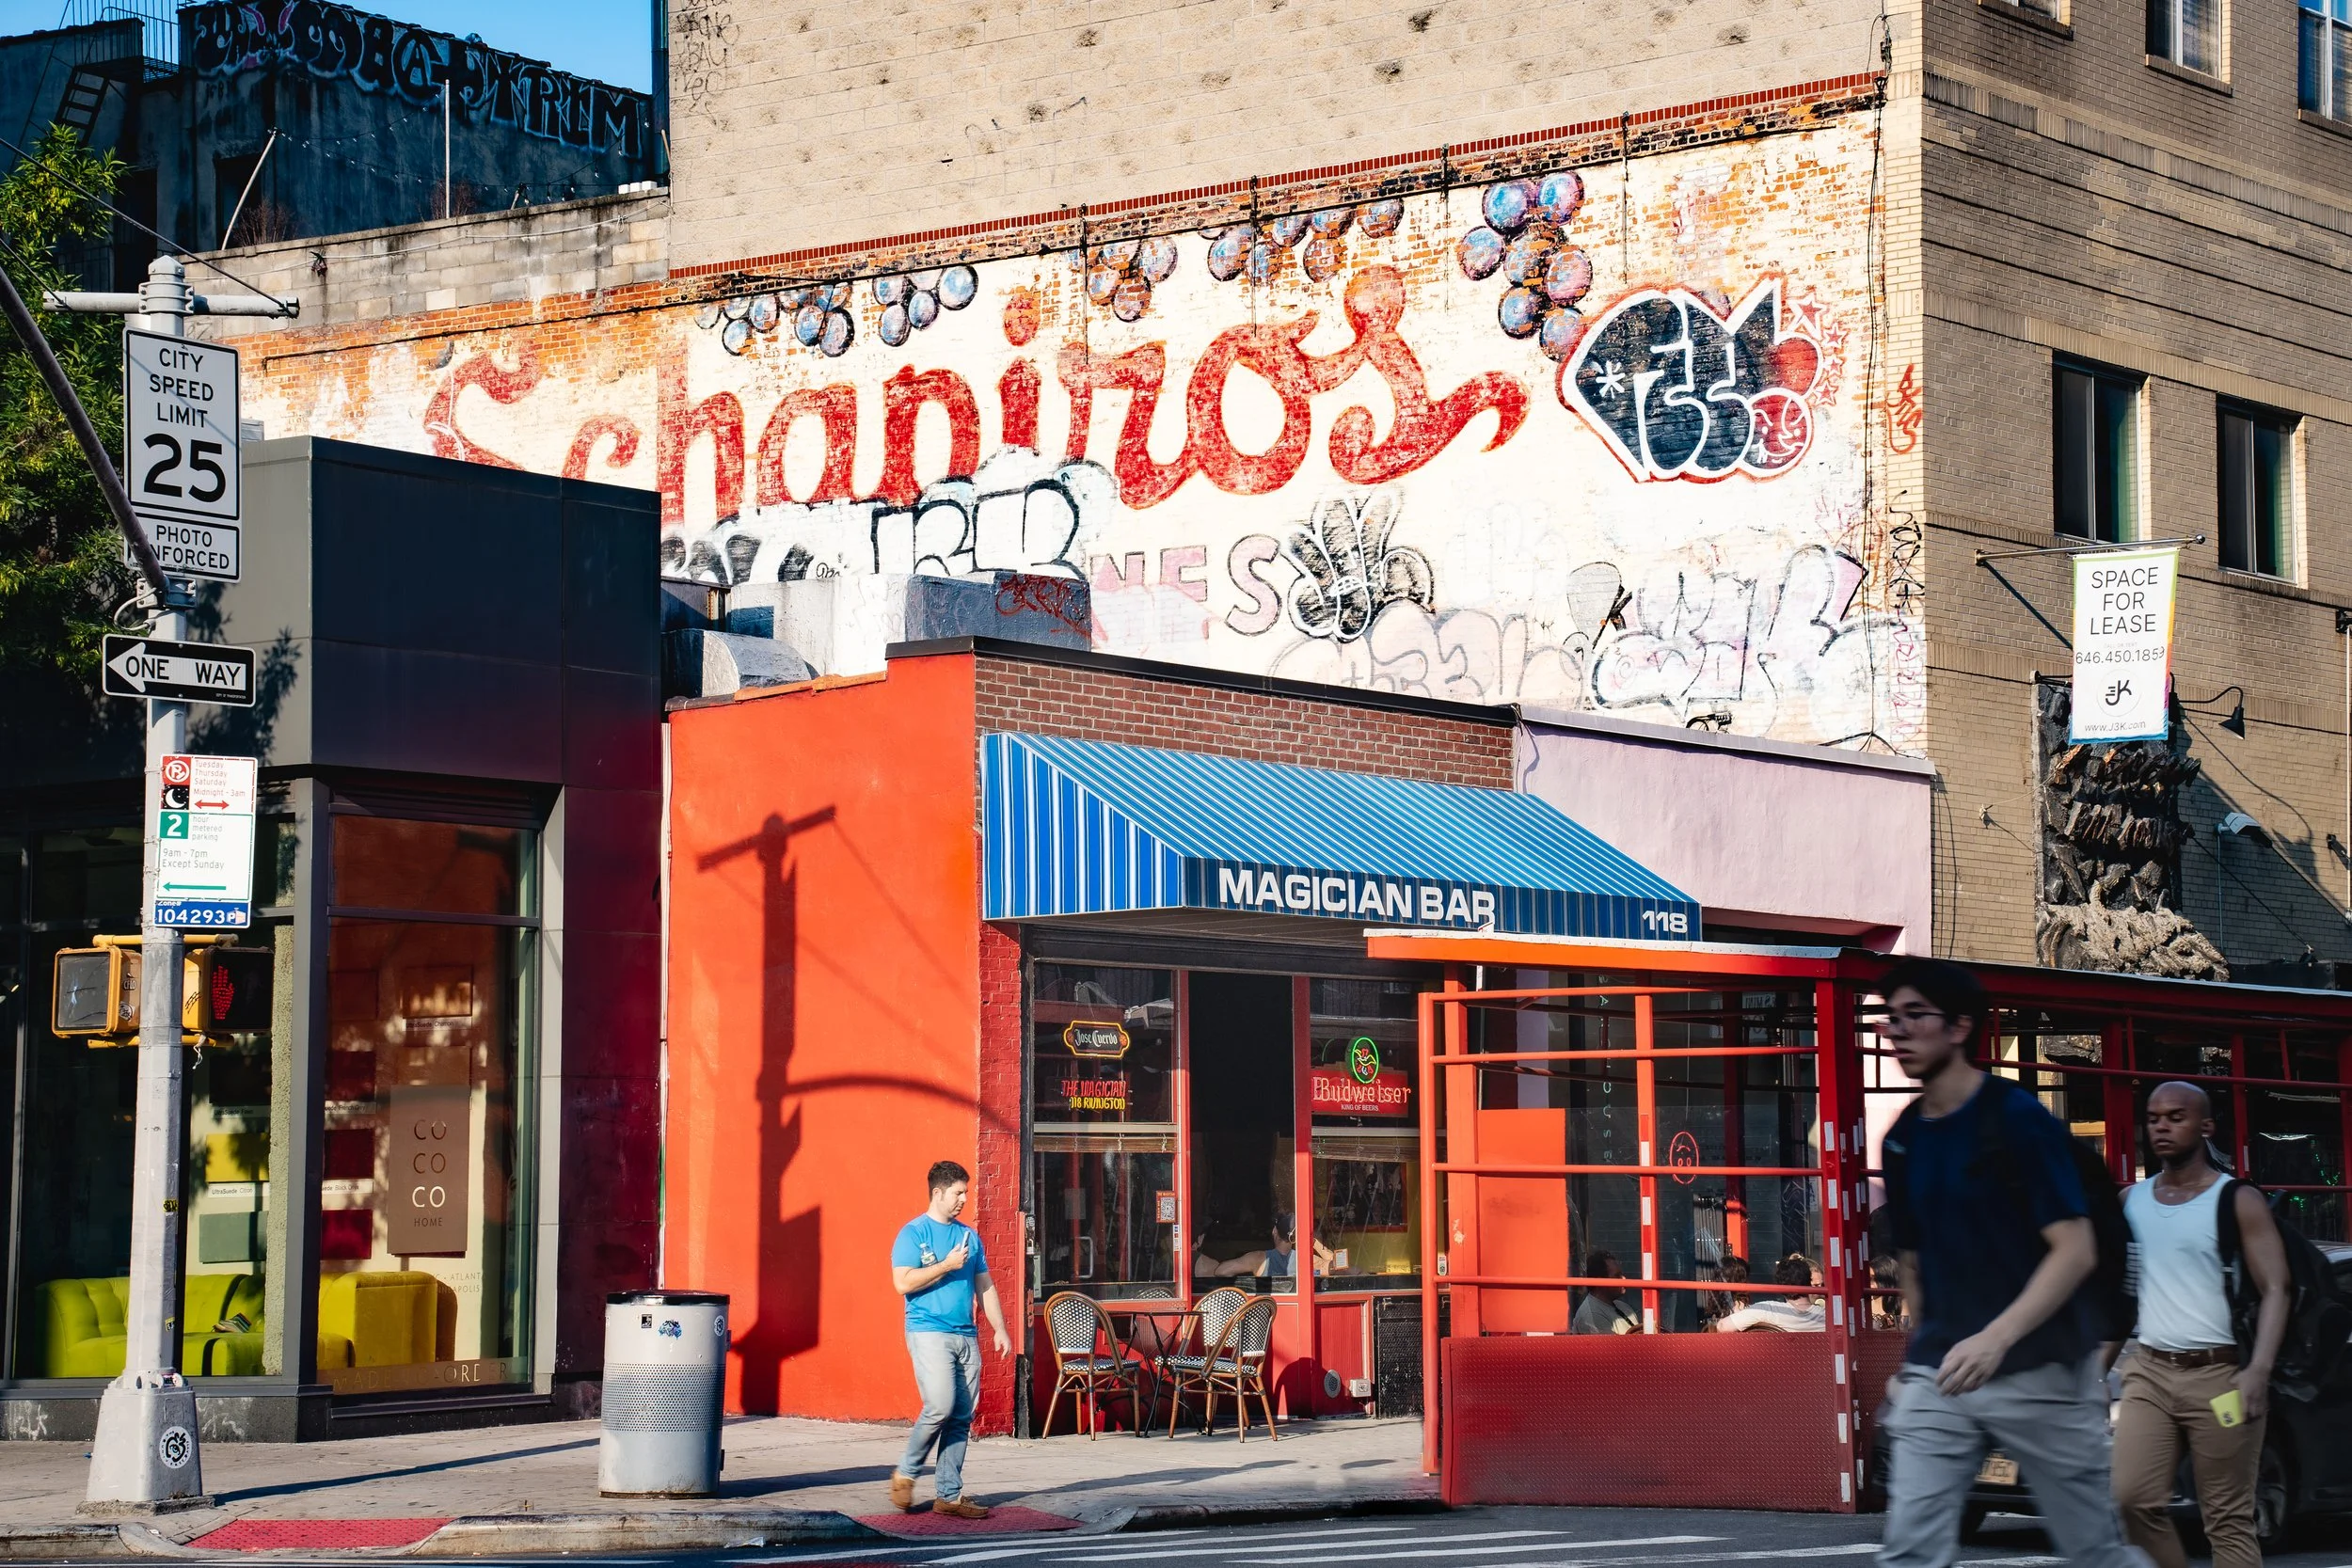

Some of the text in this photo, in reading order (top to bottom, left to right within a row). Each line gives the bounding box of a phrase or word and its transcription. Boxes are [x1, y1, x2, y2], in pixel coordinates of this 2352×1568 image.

[159, 347, 204, 372] CITY
[149, 373, 214, 402] SPEED
[156, 402, 208, 428] LIMIT
[143, 433, 227, 503] 25
[156, 524, 213, 547] PHOTO
[147, 543, 230, 570] NFORCED
[2090, 566, 2159, 590] SPACE
[2103, 591, 2145, 611] FOR
[2090, 613, 2156, 636] LEASE
[125, 655, 241, 687] ONE WAY
[2084, 720, 2146, 733] www.J3K.com
[195, 759, 225, 768] Tuesday
[195, 768, 228, 778] Thursday
[194, 778, 227, 786] Saturday
[193, 788, 224, 798] Midnight
[230, 788, 246, 798] 3am
[167, 814, 183, 837] 2
[192, 824, 223, 832] metered
[192, 833, 218, 842] parking
[163, 847, 182, 858] 9am
[190, 848, 208, 859] 7pm
[162, 859, 225, 870] Except Sunday
[1219, 867, 1496, 925] MAGICIAN BAR
[157, 909, 226, 925] 104293
[1642, 910, 1688, 934] 118
[1091, 1030, 1118, 1047] Cuervo
[1061, 1080, 1126, 1098] THE MAGICIAN
[1312, 1076, 1411, 1104] Budweiser
[1071, 1097, 1125, 1110] 118 RIVINGTON
[414, 1119, 447, 1140] CO
[413, 1152, 446, 1174] CO
[412, 1185, 446, 1208] CO
[414, 1217, 443, 1227] HOME
[450, 1272, 485, 1280] ATLANT
